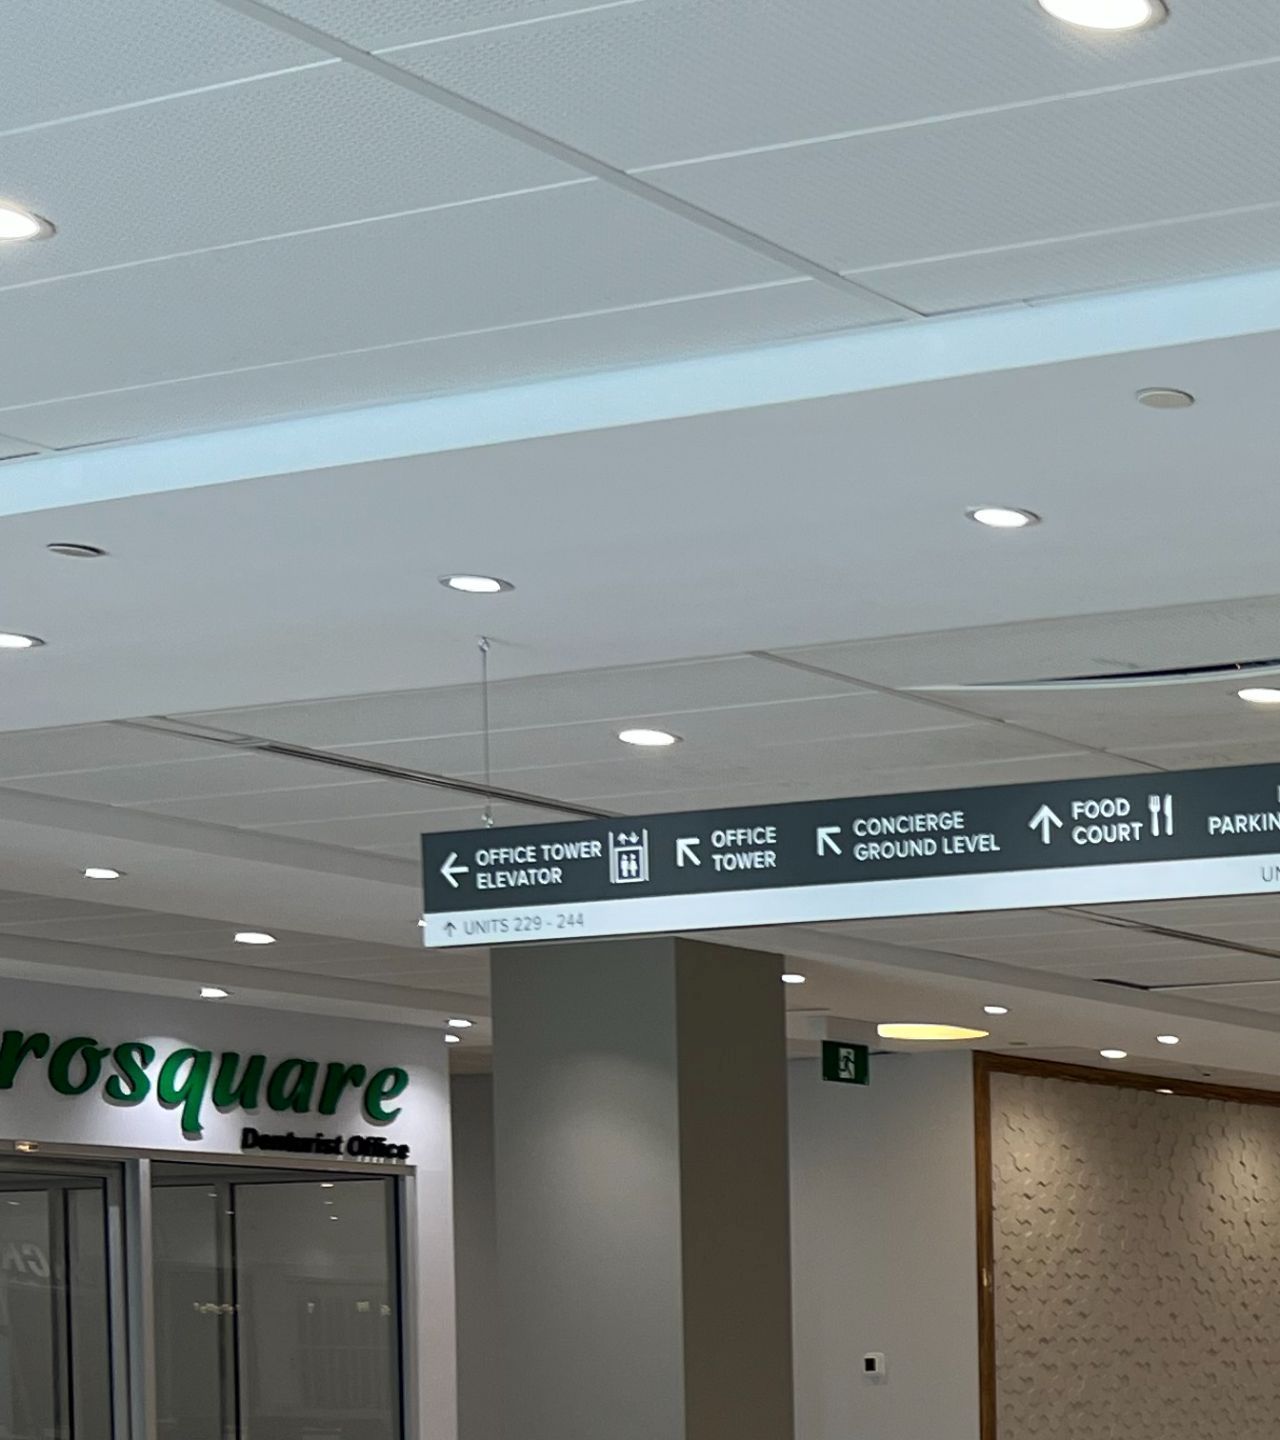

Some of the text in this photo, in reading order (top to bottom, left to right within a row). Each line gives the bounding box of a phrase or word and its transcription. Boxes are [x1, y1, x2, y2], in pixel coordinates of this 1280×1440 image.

[1071, 798, 1130, 820] FOOD
[853, 810, 965, 837] CONCIERGE
[1072, 822, 1143, 845] COURT
[711, 826, 777, 848] OFFICE
[853, 832, 1001, 861] GROUND LEVEL
[475, 841, 602, 866] OFFICE TOWER
[711, 850, 777, 871] TOWER
[476, 867, 562, 889] ELEVATOR
[465, 918, 510, 936] UNITS
[514, 915, 542, 932] 229
[556, 912, 585, 929] 244
[0, 1030, 409, 1133] rosquare
[347, 1135, 410, 1160] Office
